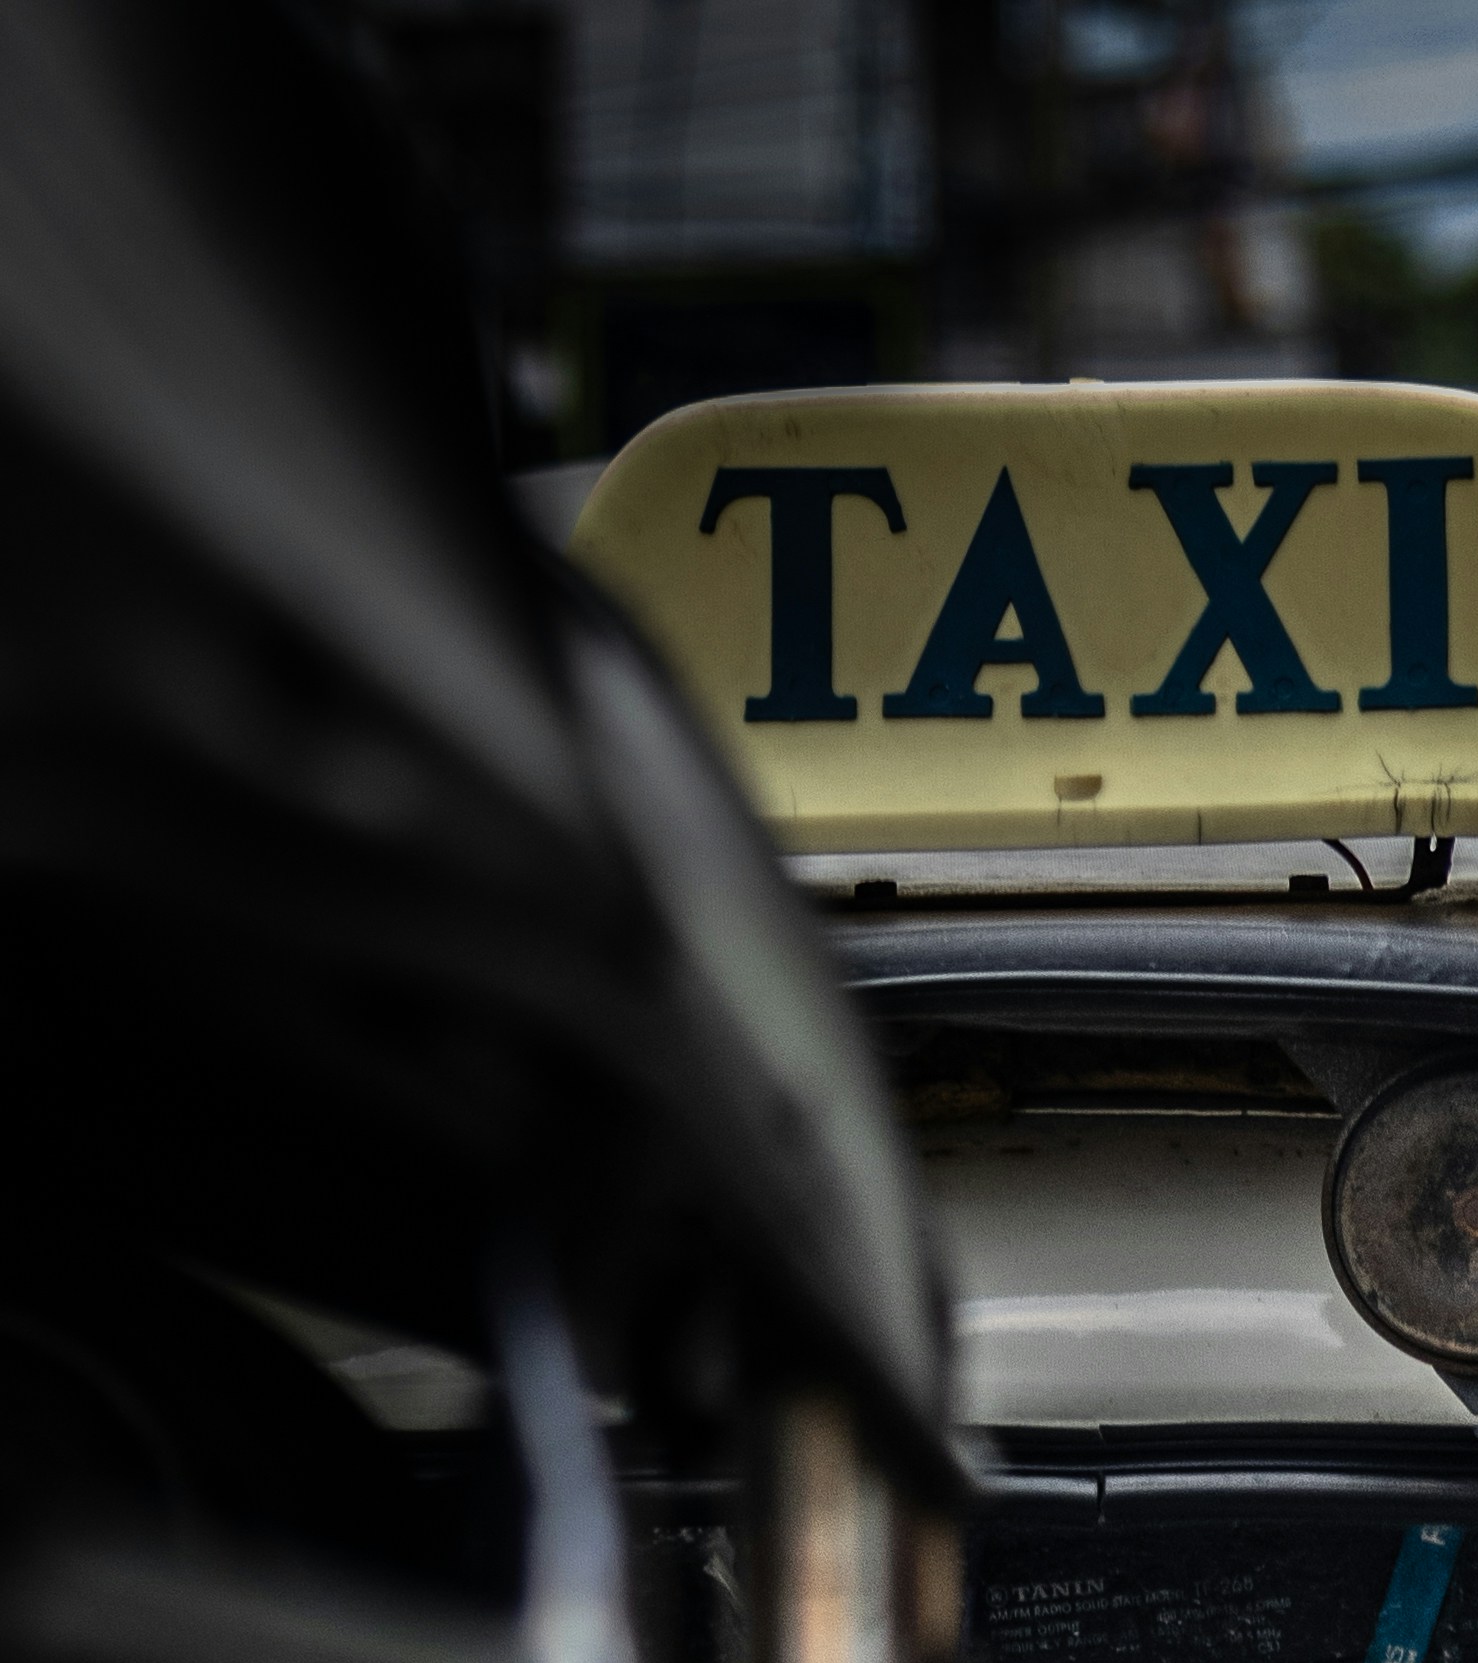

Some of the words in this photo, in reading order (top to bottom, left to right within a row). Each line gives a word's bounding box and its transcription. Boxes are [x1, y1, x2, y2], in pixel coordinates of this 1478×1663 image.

[1012, 1577, 1105, 1603] TANIN
[1034, 1602, 1072, 1618] RADIO
[1075, 1598, 1109, 1612] SOLID
